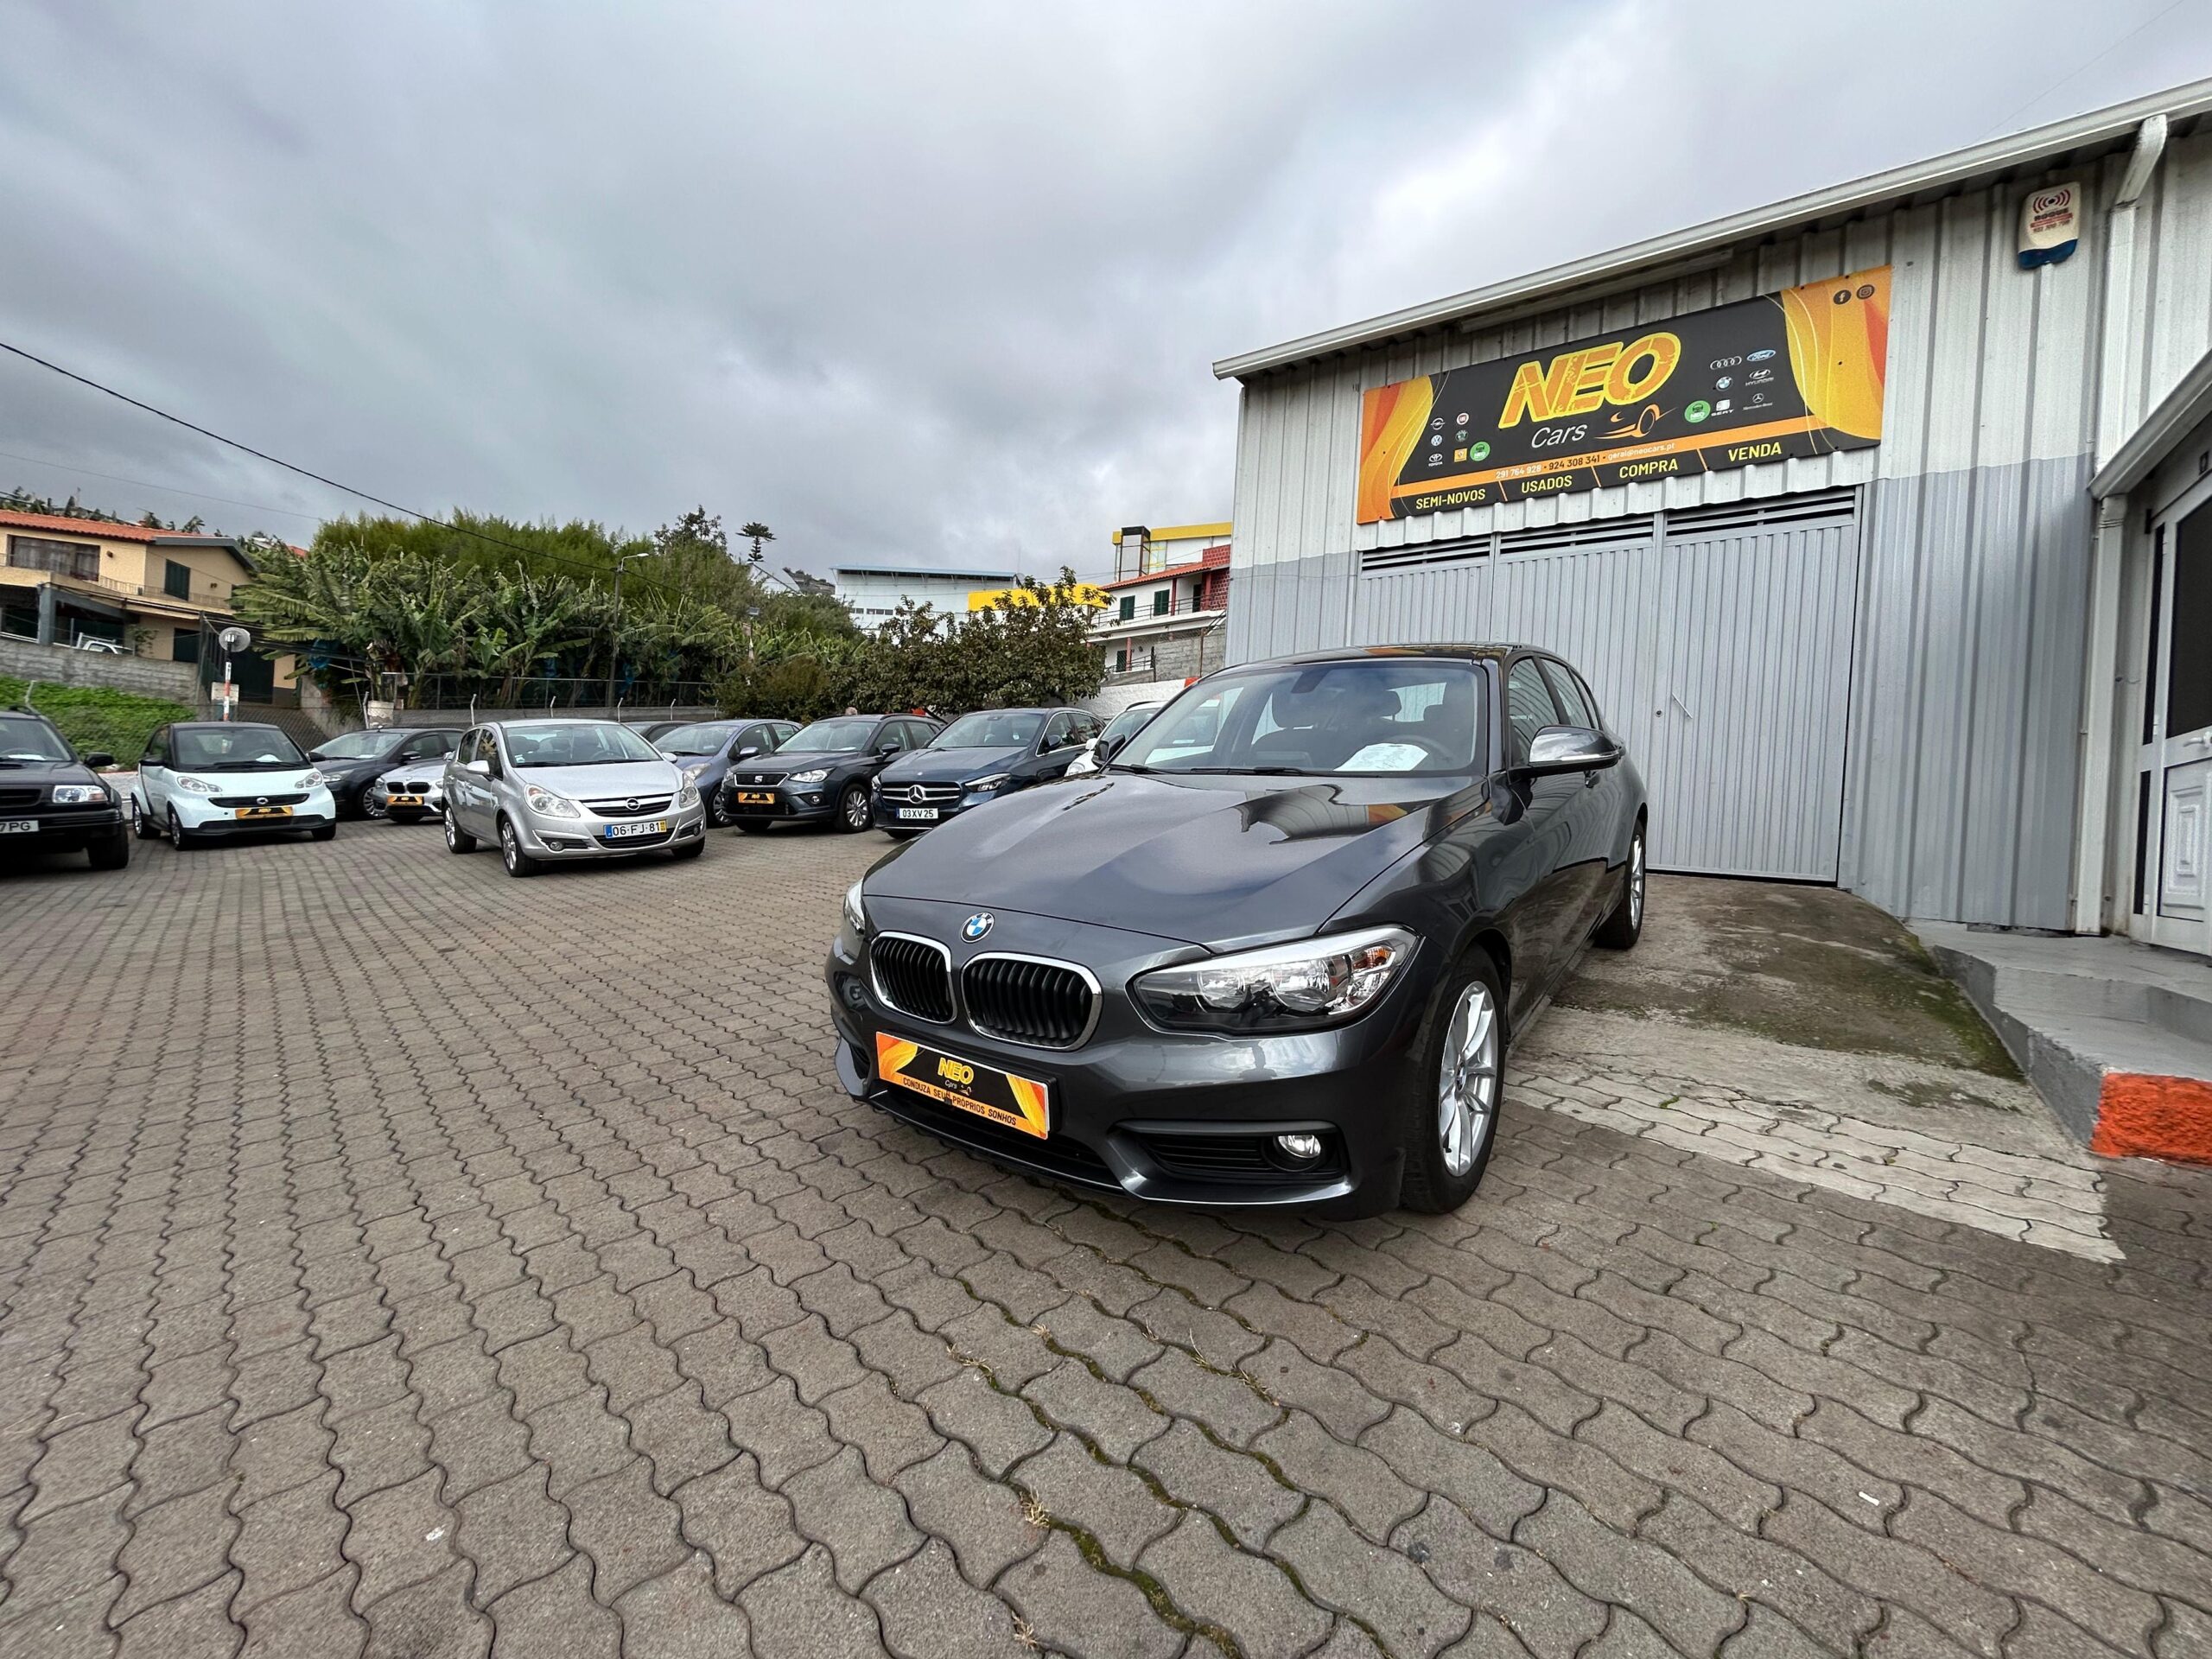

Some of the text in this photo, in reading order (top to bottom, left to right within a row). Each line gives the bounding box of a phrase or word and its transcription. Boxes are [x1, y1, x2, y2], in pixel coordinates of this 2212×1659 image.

[1498, 332, 1681, 429] NEO
[1531, 424, 1588, 448] Cars
[1496, 442, 1675, 480] 291 764 928 924 308 341 geral@neocars.pt
[1728, 442, 1782, 462] VENDA
[1619, 459, 1678, 479] COMPRA
[1521, 474, 1573, 493] USADOS
[1416, 488, 1486, 509] SEMI-NOVOS
[938, 1057, 975, 1084] NEO
[944, 1079, 957, 1089] Cars
[903, 1077, 931, 1095] CONDUZA
[952, 1096, 985, 1115] PRÓPRIOS
[988, 1109, 1017, 1126] SONHOS
